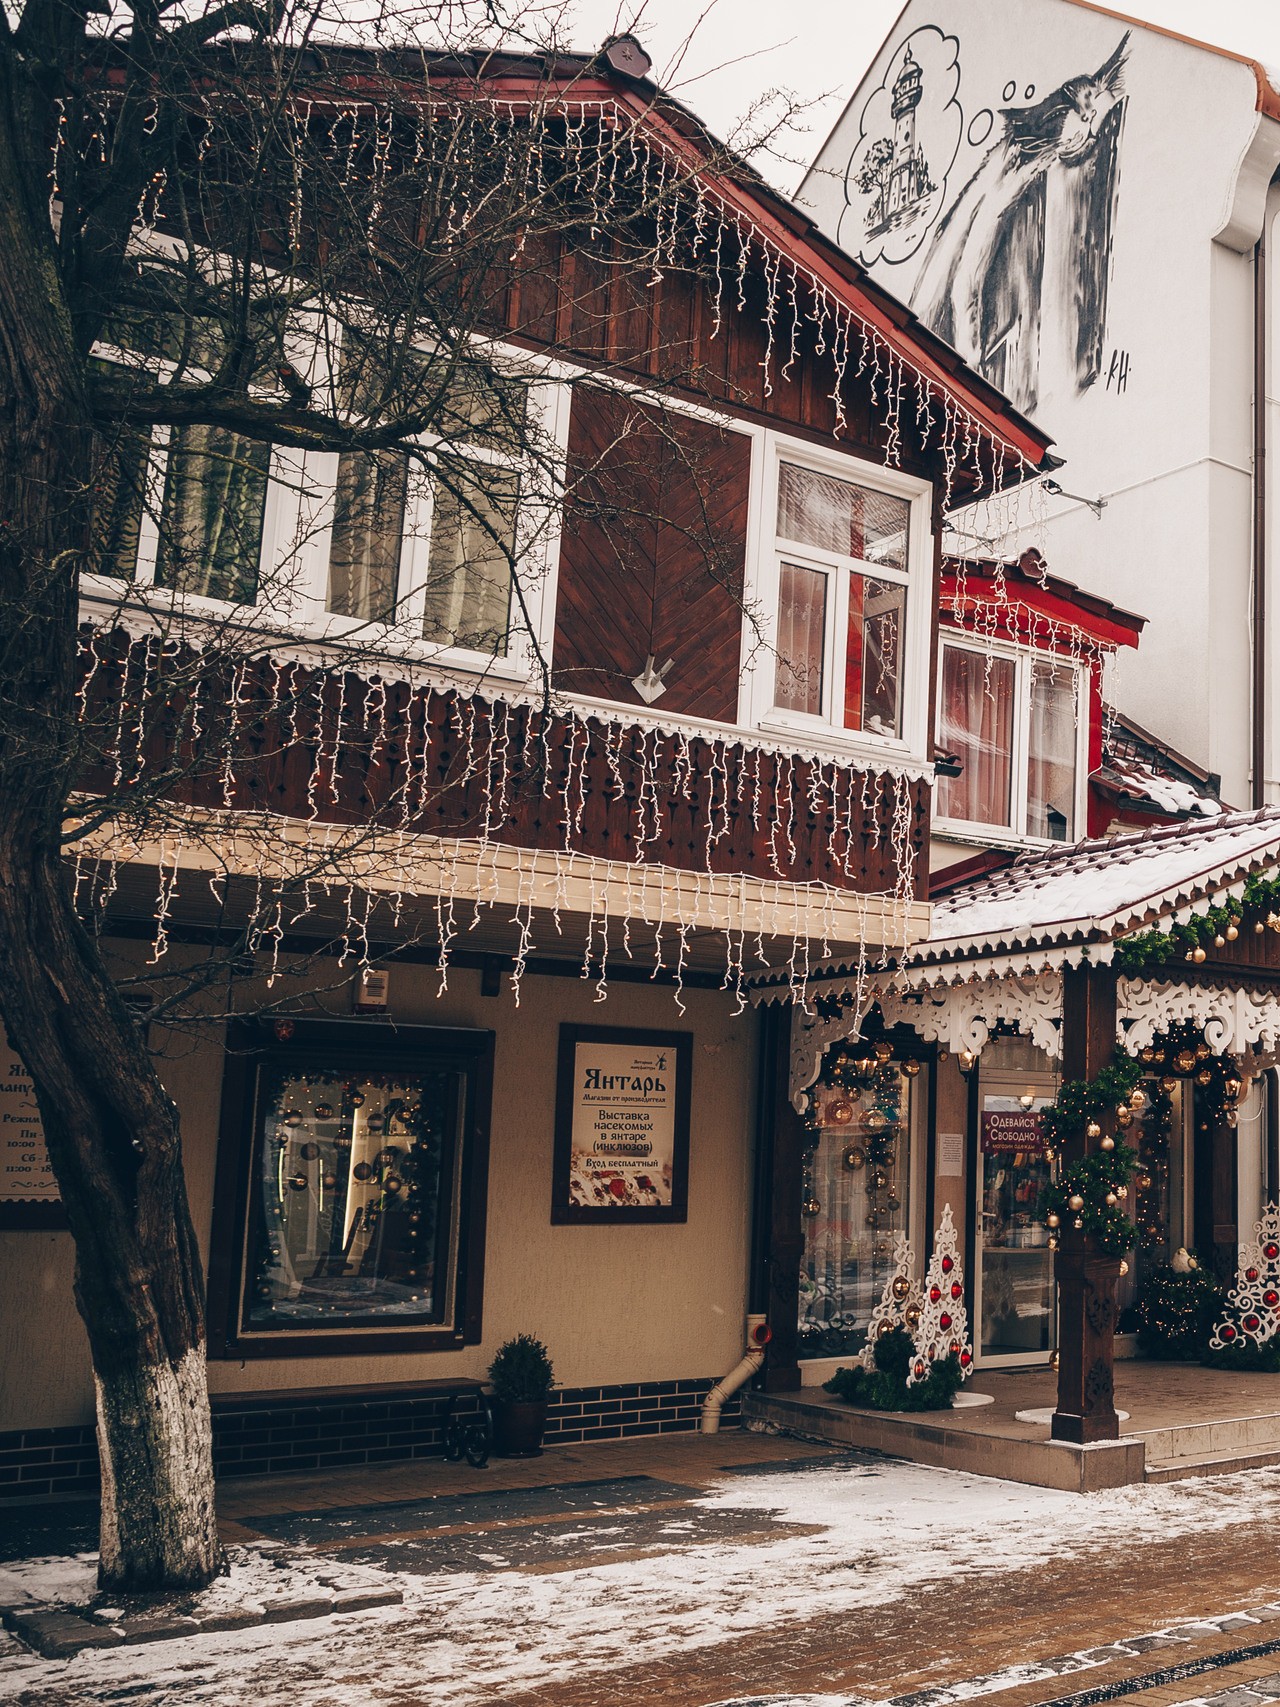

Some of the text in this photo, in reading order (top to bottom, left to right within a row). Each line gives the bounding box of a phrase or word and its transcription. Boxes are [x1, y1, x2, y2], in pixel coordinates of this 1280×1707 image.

[583, 1068, 666, 1097] Янтарь
[3, 1114, 40, 1124] Режим
[599, 1109, 650, 1121] Выставка
[594, 1122, 654, 1131] насекомых
[20, 1130, 37, 1138] Пн
[601, 1132, 646, 1143] в янтаре
[593, 1140, 653, 1154] (инклюзов)
[21, 1154, 36, 1162] Сб
[586, 1158, 659, 1169] Вход бесплатный
[41, 1165, 52, 1173] 18
